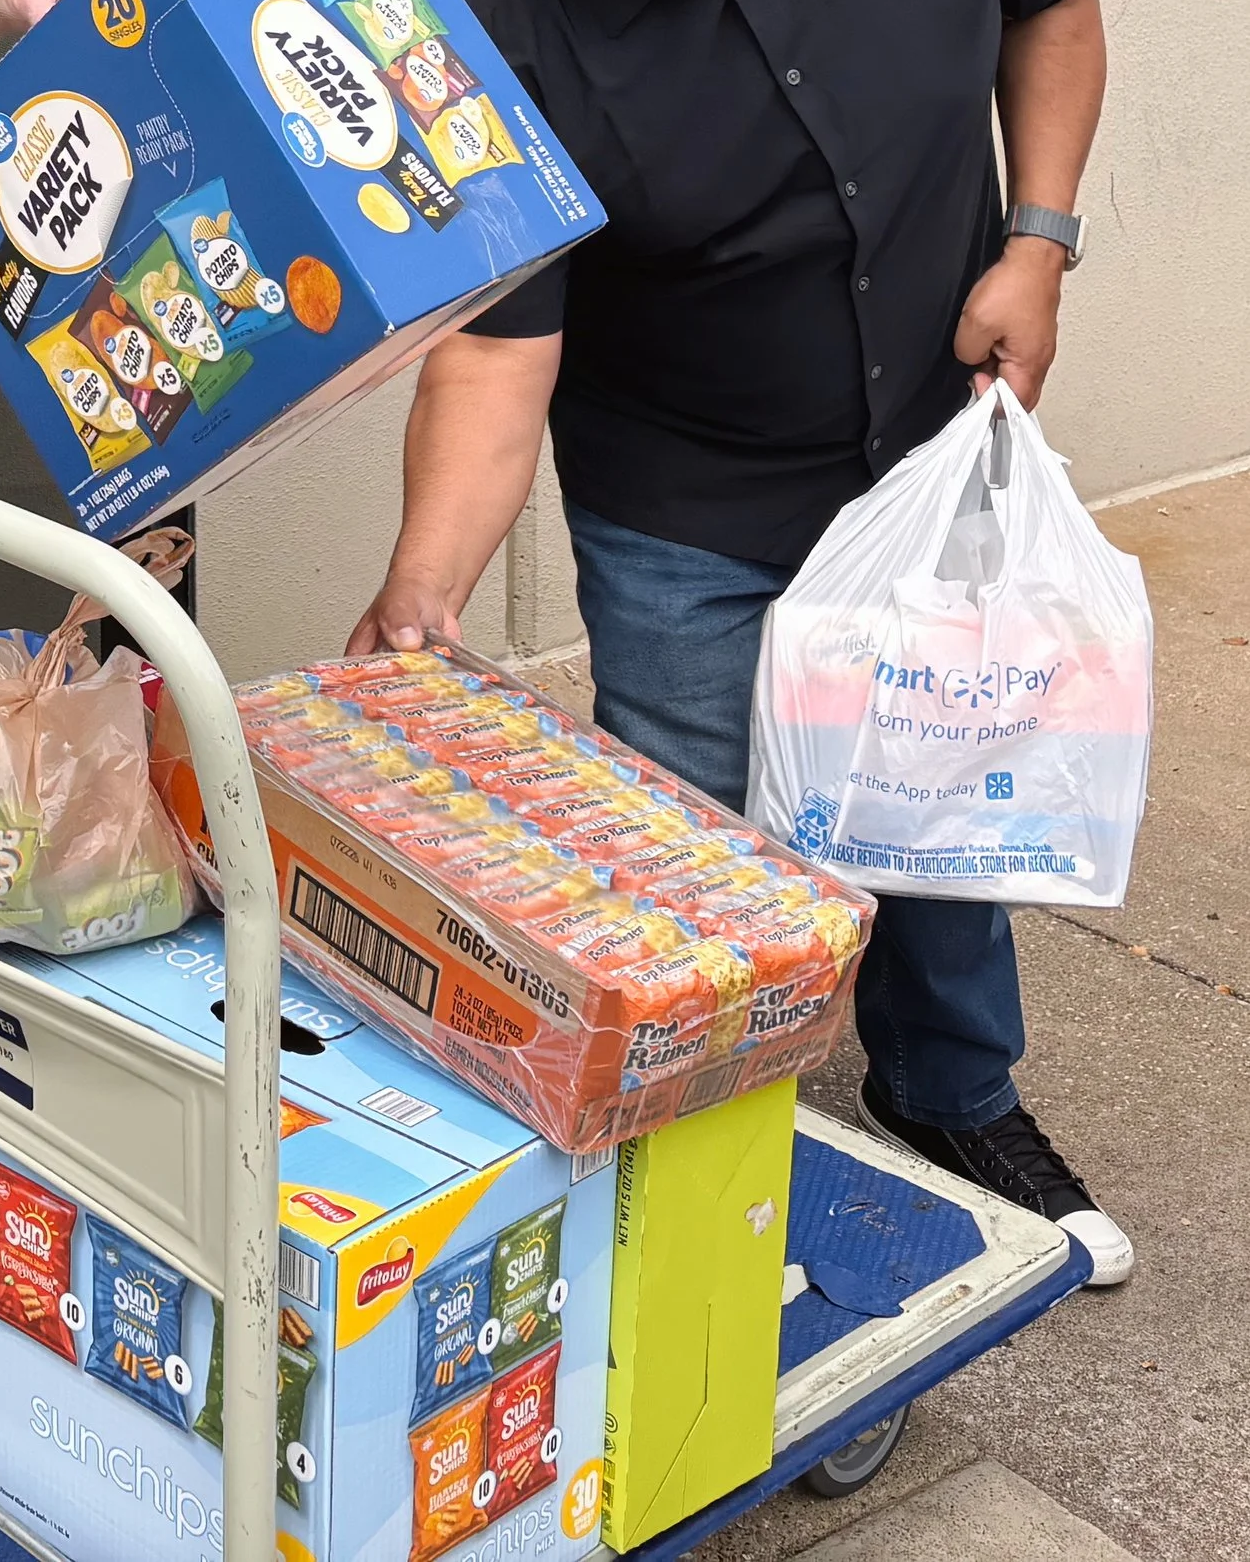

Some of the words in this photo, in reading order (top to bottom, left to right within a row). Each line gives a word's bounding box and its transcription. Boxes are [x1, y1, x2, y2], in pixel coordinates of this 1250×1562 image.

[265, 29, 367, 147] VARIETY
[303, 34, 378, 111] PACK
[274, 69, 331, 127] CLASSIC
[136, 114, 171, 144] PANTRY
[13, 115, 55, 183] CLASSIC
[135, 140, 163, 166] READY
[160, 130, 189, 161] PACK
[17, 110, 94, 238] VARIETY
[401, 152, 455, 208] FLAVORS
[49, 164, 103, 252] PACK
[204, 243, 238, 278] POTATO
[214, 258, 240, 286] CHIPS
[3, 267, 38, 331] FLAVORS
[167, 296, 194, 342] POTATO
[178, 314, 199, 346] CHIPS
[119, 330, 140, 376] POTATO
[126, 347, 147, 383] CHIPS
[72, 373, 100, 408] POTATO
[81, 385, 103, 414] CHIPS
[1006, 663, 1055, 697] Pay
[920, 721, 969, 742] your
[977, 715, 1038, 745] phone
[846, 771, 862, 786] et
[865, 774, 891, 794] the
[895, 782, 930, 801] App
[936, 781, 978, 801] today
[857, 849, 890, 870] RETURN
[893, 855, 904, 872] TO
[907, 856, 914, 873] A
[915, 855, 978, 874] PARTICIPATING
[979, 855, 1006, 874] STORE
[1008, 856, 1025, 874] FOR
[1028, 854, 1076, 874] RECYCLING
[633, 968, 661, 987] Top
[753, 983, 795, 1009] Top
[746, 993, 832, 1037] Ramen
[622, 1030, 711, 1072] Ramen
[622, 1175, 633, 1192] OZ
[622, 1192, 631, 1202] 5
[619, 1201, 631, 1221] WT
[5, 1209, 51, 1251] Sun
[618, 1222, 628, 1247] NET
[20, 1237, 51, 1262] CHIPS
[505, 1246, 544, 1292] Sun
[519, 1263, 544, 1283] CHIPS
[114, 1276, 160, 1316] Sun
[554, 1286, 562, 1304] 4
[65, 1300, 80, 1324] 10
[128, 1302, 159, 1327] CHIPS
[435, 1291, 472, 1335] Sun
[448, 1307, 472, 1326] CHIPS
[485, 1328, 493, 1346] 6
[174, 1364, 184, 1385] 6
[501, 1393, 538, 1441] Sun
[514, 1409, 539, 1430] CHIPS
[546, 1436, 558, 1456] 10
[29, 1394, 224, 1554] sunchips
[296, 1454, 306, 1474] 4
[429, 1438, 465, 1486] Sun
[443, 1455, 468, 1475] CHIPS
[478, 1479, 490, 1501] 10
[570, 1468, 599, 1518] 30
[534, 1531, 556, 1557] MIX
